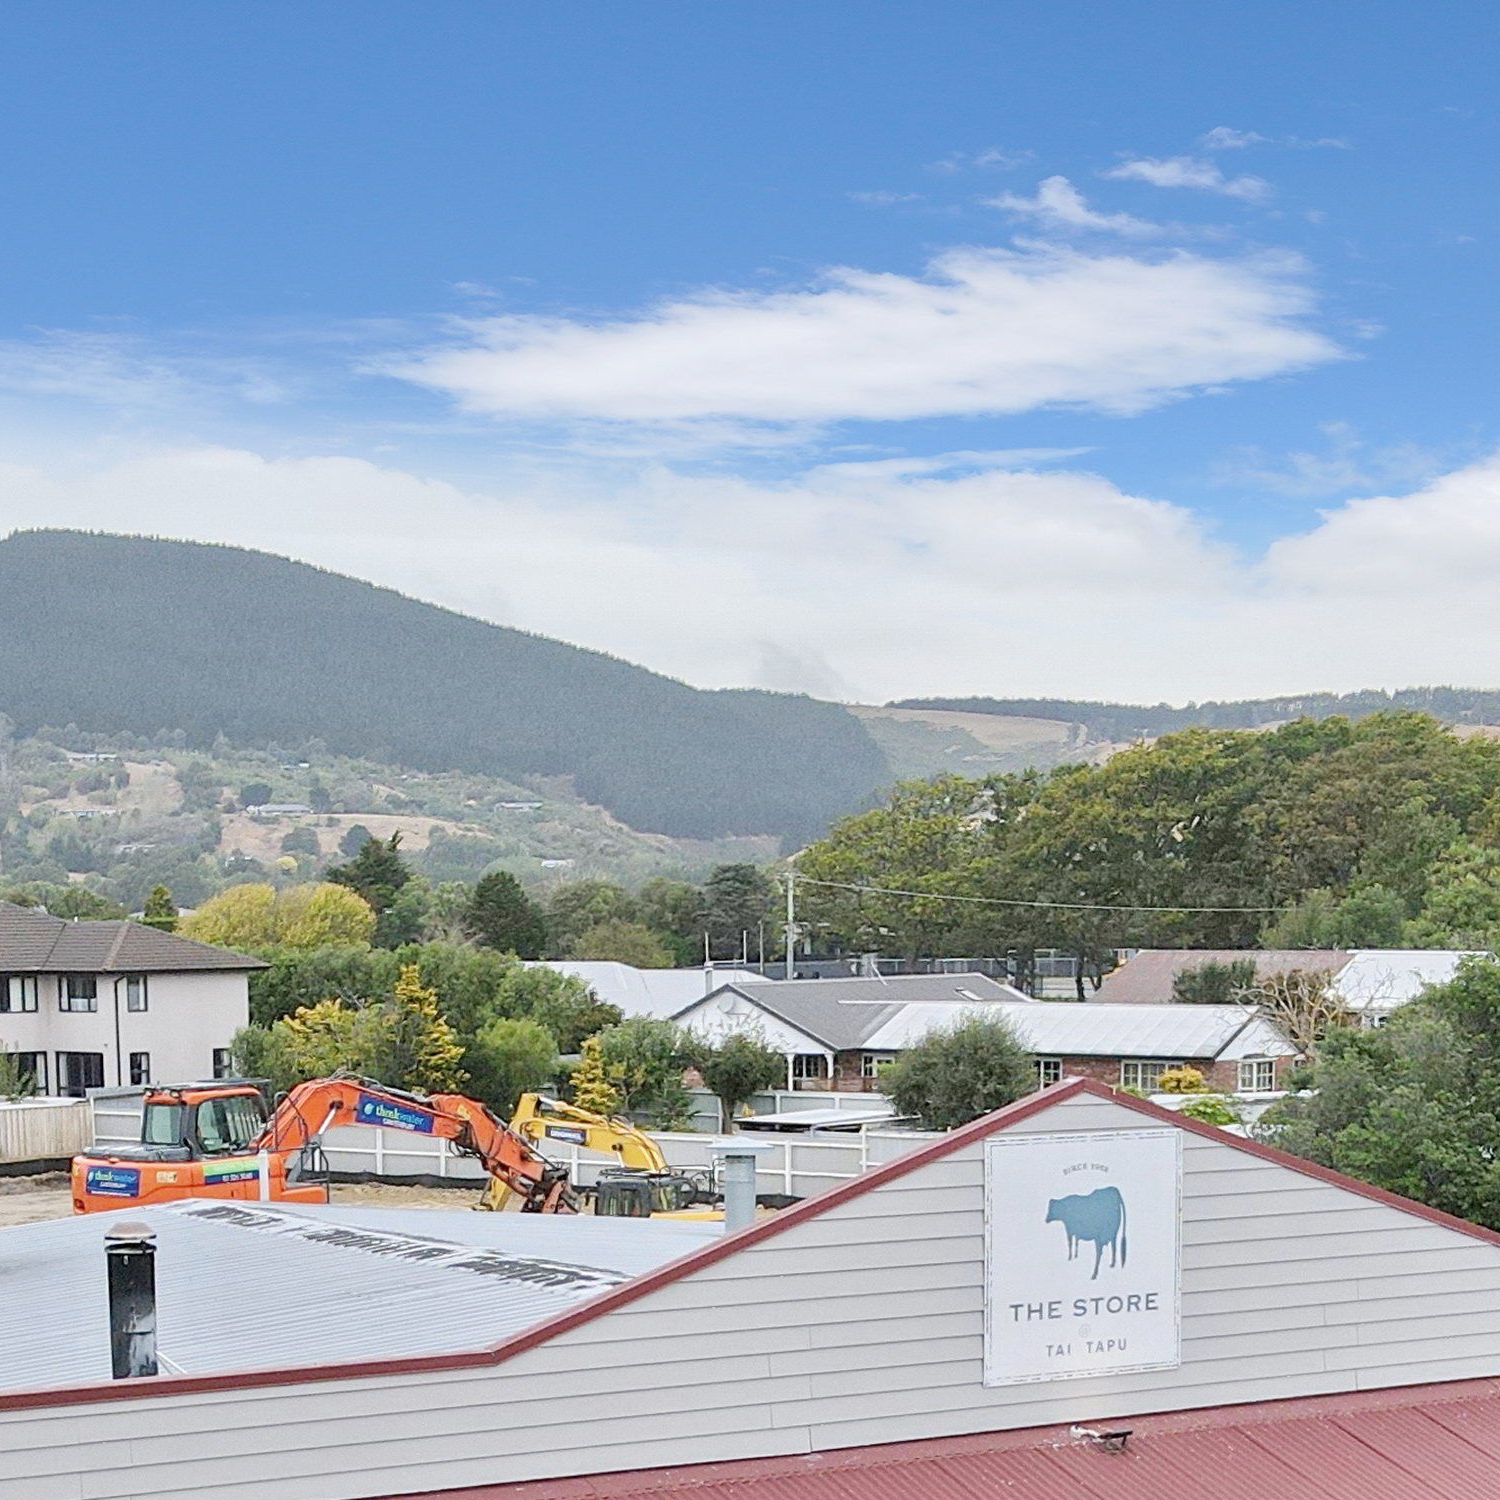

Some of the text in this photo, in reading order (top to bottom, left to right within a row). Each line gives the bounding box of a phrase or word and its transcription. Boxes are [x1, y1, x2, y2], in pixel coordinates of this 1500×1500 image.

[1009, 1292, 1160, 1322] THE STORE
[1045, 1337, 1128, 1357] TAI TAPU
